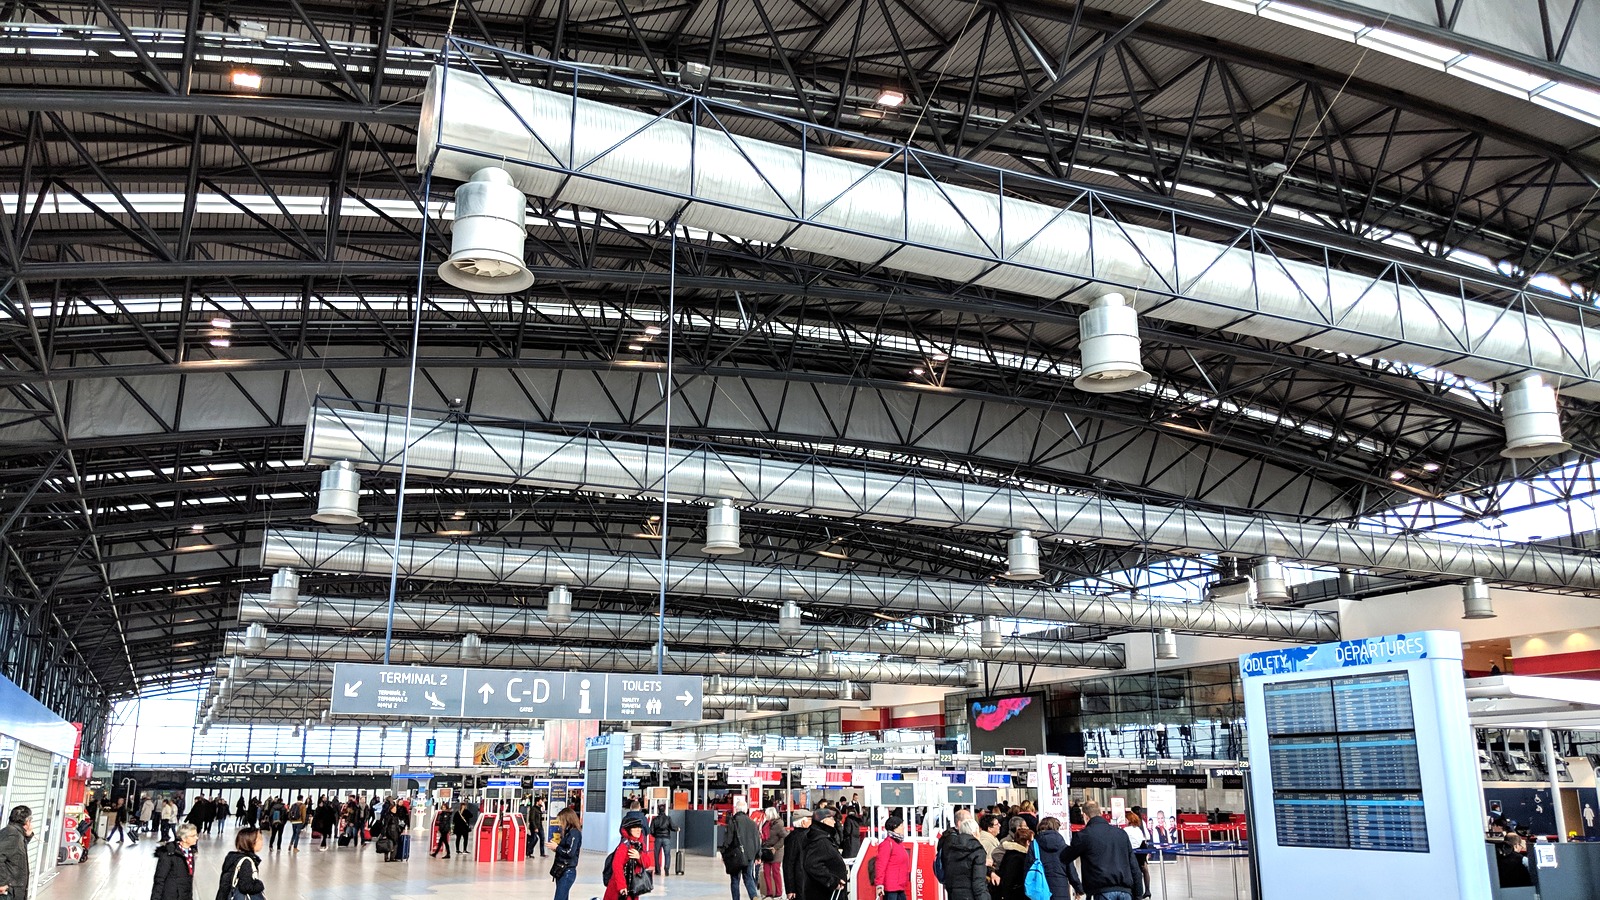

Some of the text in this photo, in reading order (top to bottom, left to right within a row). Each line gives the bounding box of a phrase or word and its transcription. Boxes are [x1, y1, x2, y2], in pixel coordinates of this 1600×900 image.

[1335, 637, 1424, 663] DEPARTURES
[1244, 654, 1287, 672] ODLETY
[379, 671, 448, 686] TERMINAL 2
[621, 680, 662, 692] TOILETS
[506, 678, 550, 704] C-D
[219, 763, 272, 773] GATES C-D
